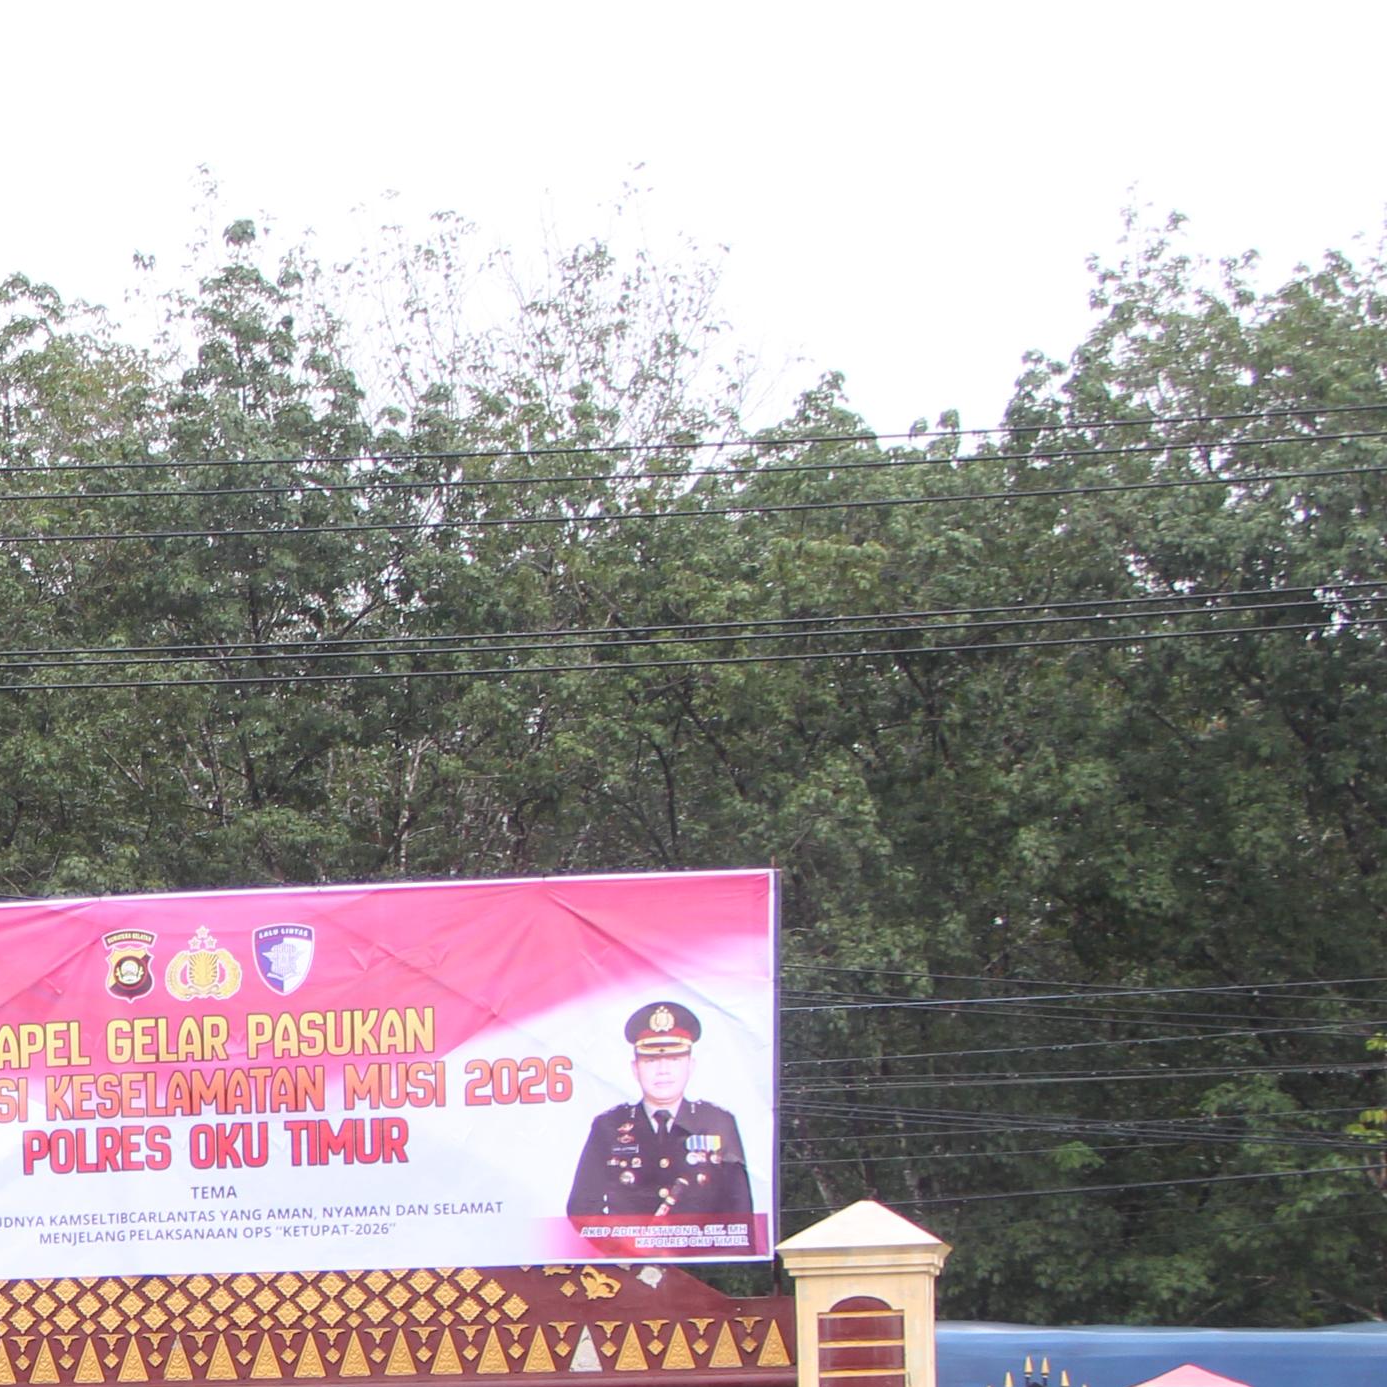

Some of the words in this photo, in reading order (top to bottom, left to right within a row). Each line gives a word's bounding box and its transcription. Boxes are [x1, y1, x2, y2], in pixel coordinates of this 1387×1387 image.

[259, 929, 278, 939] LALU
[281, 928, 309, 937] LINTAS
[106, 1015, 229, 1065] GELAR
[246, 1006, 435, 1060] PASUKAN
[45, 1065, 326, 1121] KESELAMATAN
[343, 1060, 446, 1111] MUSI
[464, 1055, 573, 1106] 2026
[22, 1125, 172, 1176] POLRES
[189, 1121, 269, 1170] OKU
[283, 1117, 409, 1167] TIMUR
[190, 1186, 238, 1200] TEMA
[49, 1210, 216, 1226] KAMSELTIBCARLANTAS
[220, 1208, 262, 1222] YANG
[266, 1206, 318, 1221] AMAN,
[322, 1204, 391, 1219] NYAMAN
[396, 1203, 429, 1217] DAN
[433, 1201, 503, 1215] SELAMAT
[39, 1230, 126, 1246] MENJELANG
[129, 1227, 238, 1242] PELAKSANAAN
[242, 1226, 272, 1239] OPS
[635, 1237, 689, 1248] KAPOLRES
[689, 1236, 712, 1247] OKU
